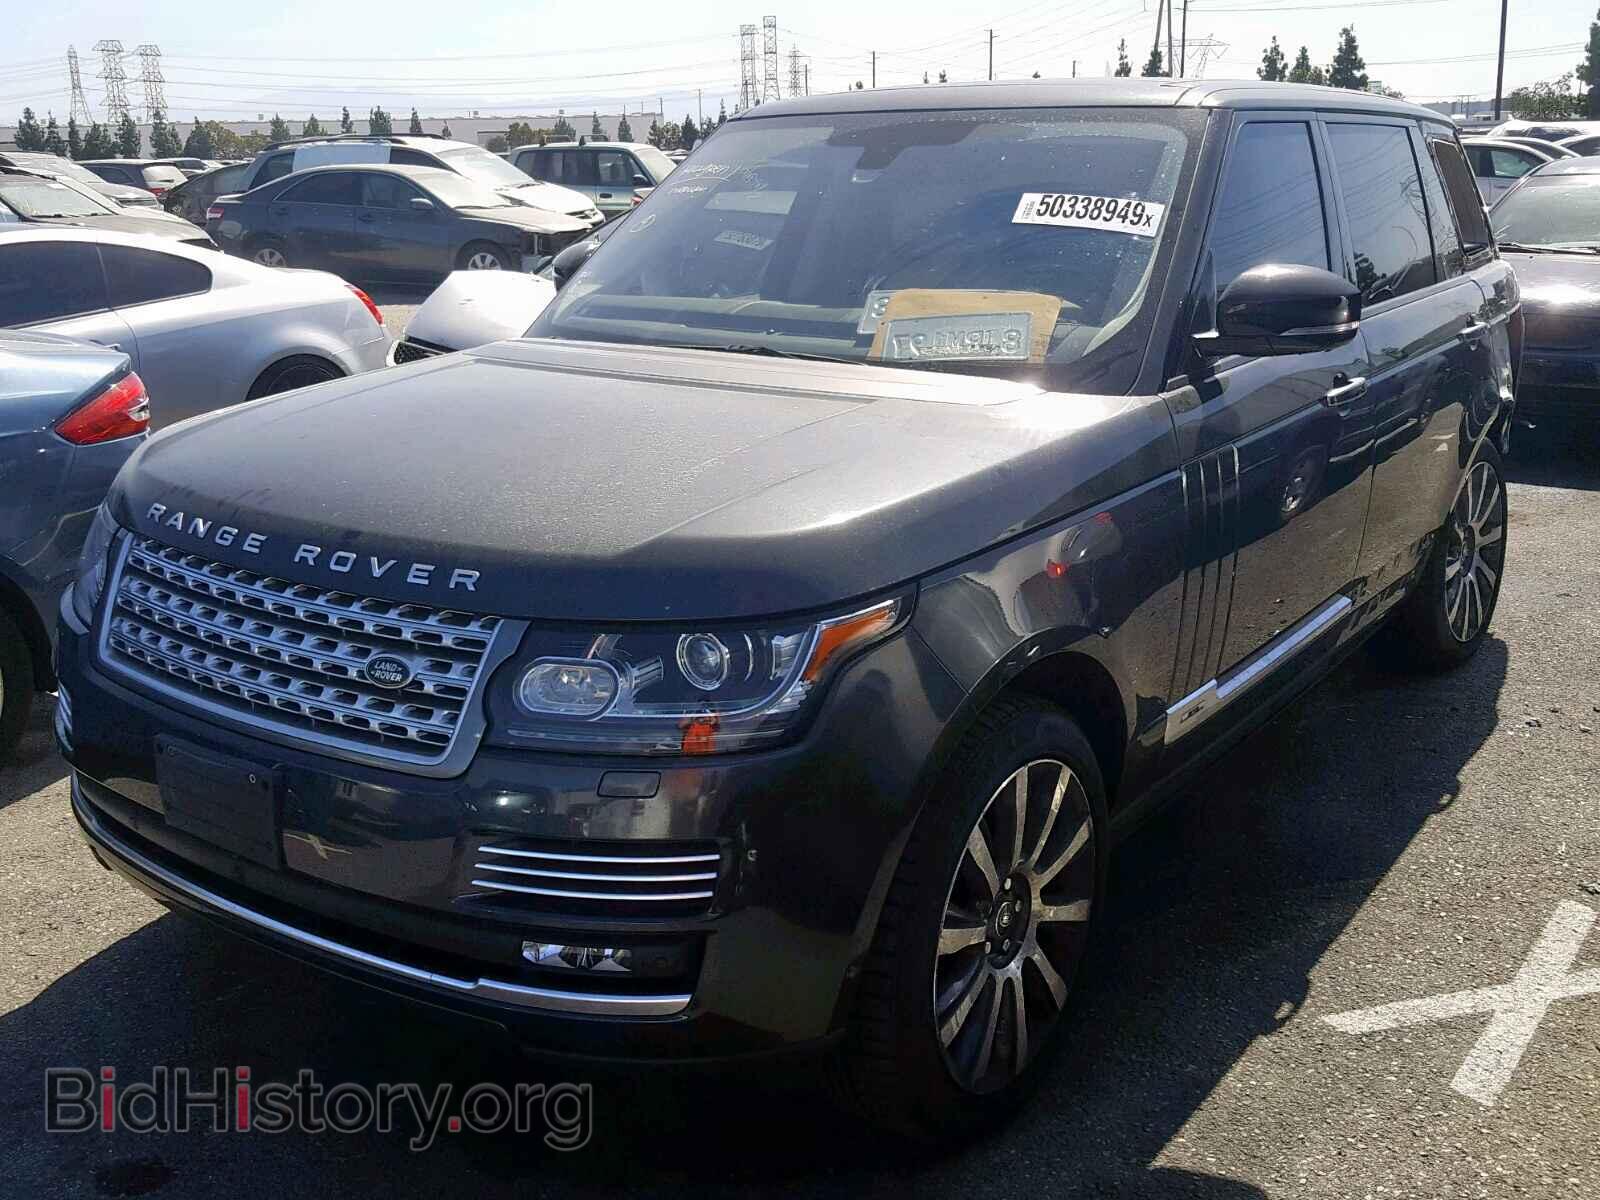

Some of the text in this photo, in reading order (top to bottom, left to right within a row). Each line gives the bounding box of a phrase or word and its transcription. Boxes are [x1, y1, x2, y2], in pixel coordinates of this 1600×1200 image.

[146, 502, 481, 592] RANGE ROVER
[374, 660, 398, 671] LAND
[374, 670, 403, 682] ROVER
